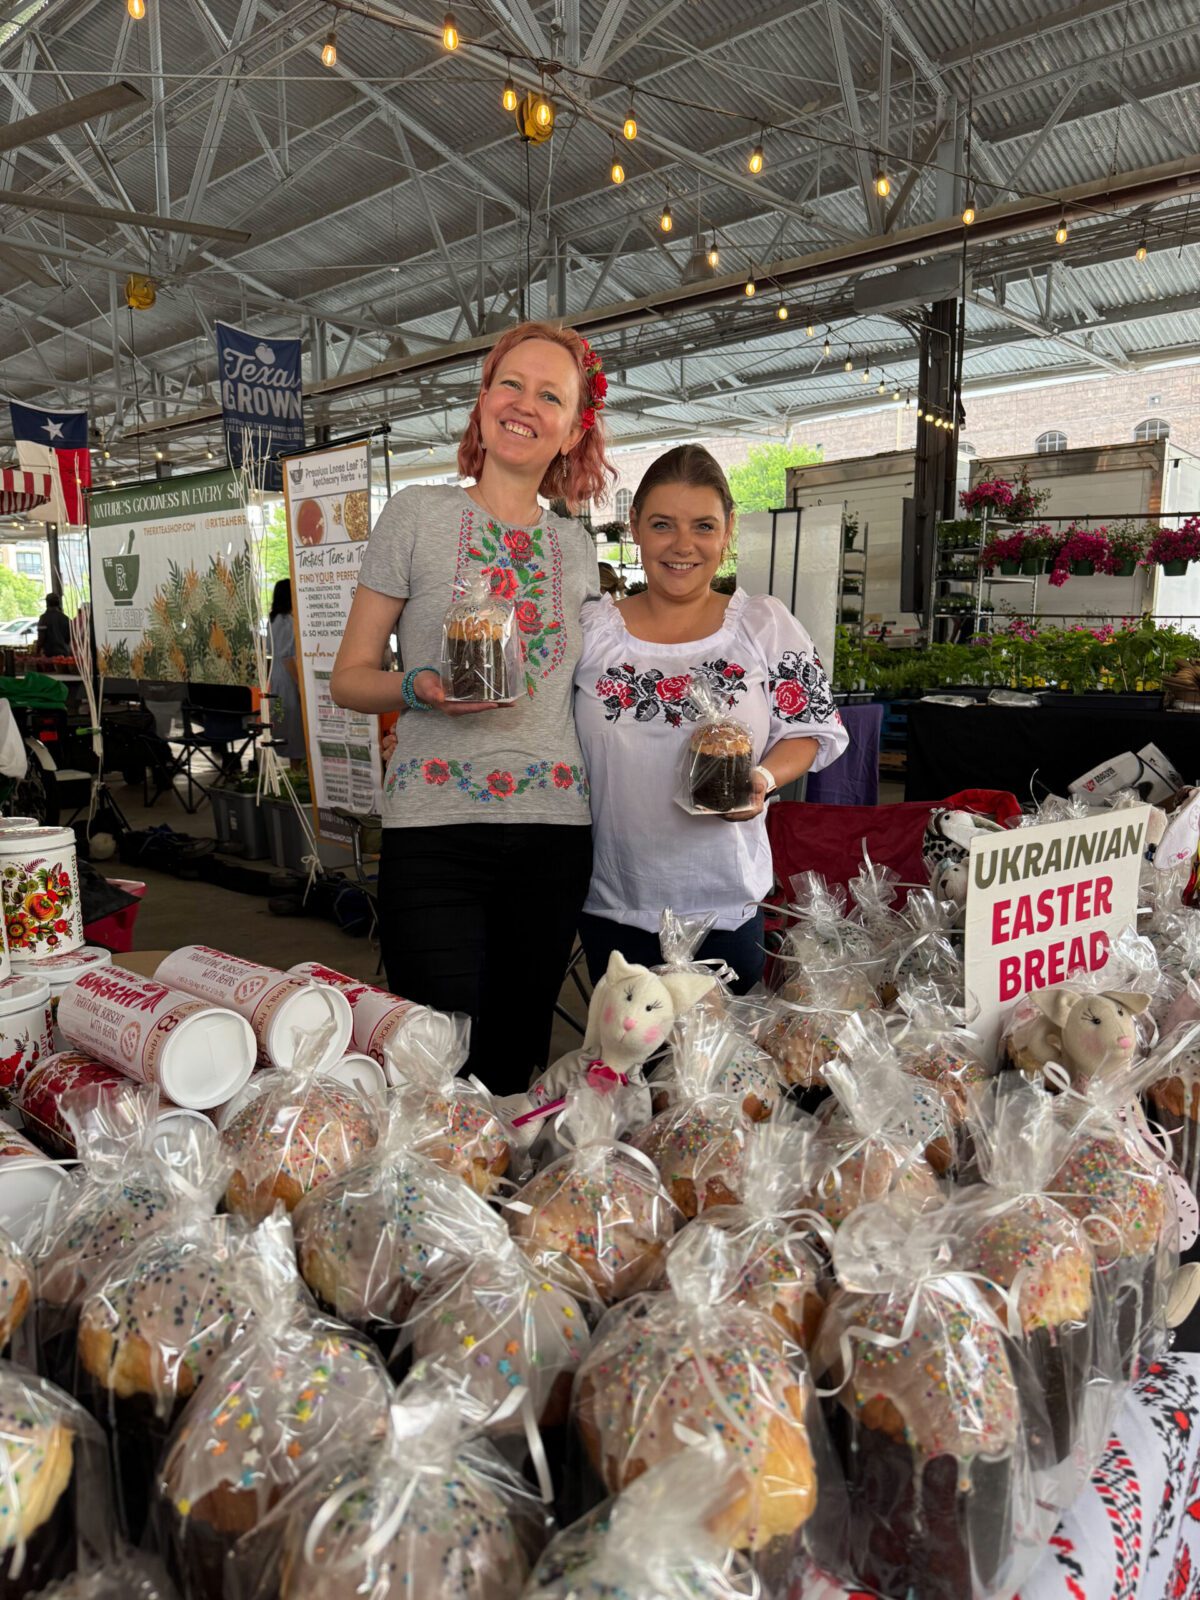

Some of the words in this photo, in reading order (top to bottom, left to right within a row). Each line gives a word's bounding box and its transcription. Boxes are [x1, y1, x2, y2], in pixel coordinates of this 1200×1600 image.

[223, 347, 300, 389] Texas
[222, 379, 302, 420] GROWN
[305, 467, 328, 479] Premium
[329, 463, 345, 475] Loose
[346, 459, 358, 472] Leaf
[312, 475, 340, 488] Apothecary
[341, 472, 355, 482] Herbs
[93, 501, 131, 519] NATURE'S
[132, 490, 180, 514] GOODNESS
[181, 490, 191, 506] IN
[192, 483, 225, 505] EVERY
[143, 522, 196, 536] THERXTEASHOP.COM
[104, 558, 113, 567] THE
[326, 547, 345, 566] Teas
[346, 549, 354, 563] in
[299, 573, 315, 584] FIND
[315, 571, 334, 584] YOUR
[327, 592, 341, 600] FOCUS
[104, 608, 123, 628] TEA
[124, 607, 144, 628] SHOP
[308, 629, 316, 637] SO
[317, 629, 328, 637] MUCH
[974, 822, 1145, 890] UKRAINIAN
[991, 875, 1114, 946] EASTER
[187, 952, 222, 971] TRADITIONAL
[219, 961, 251, 978] BORSCHT
[999, 929, 1111, 1003] BREAD
[201, 967, 220, 982] WITH
[219, 972, 239, 987] BEANS
[75, 971, 146, 1013] BORSCHT
[266, 985, 293, 1010] FAMILY
[73, 993, 103, 1016] TRADITIONAL
[100, 1006, 126, 1027] BORSCHT
[89, 1017, 103, 1033] WITH
[102, 1023, 119, 1043] BEANS
[157, 1014, 180, 1033] 8
[377, 1019, 396, 1041] PACK
[147, 1033, 162, 1069] FAMILY
[368, 1048, 385, 1068] 8
